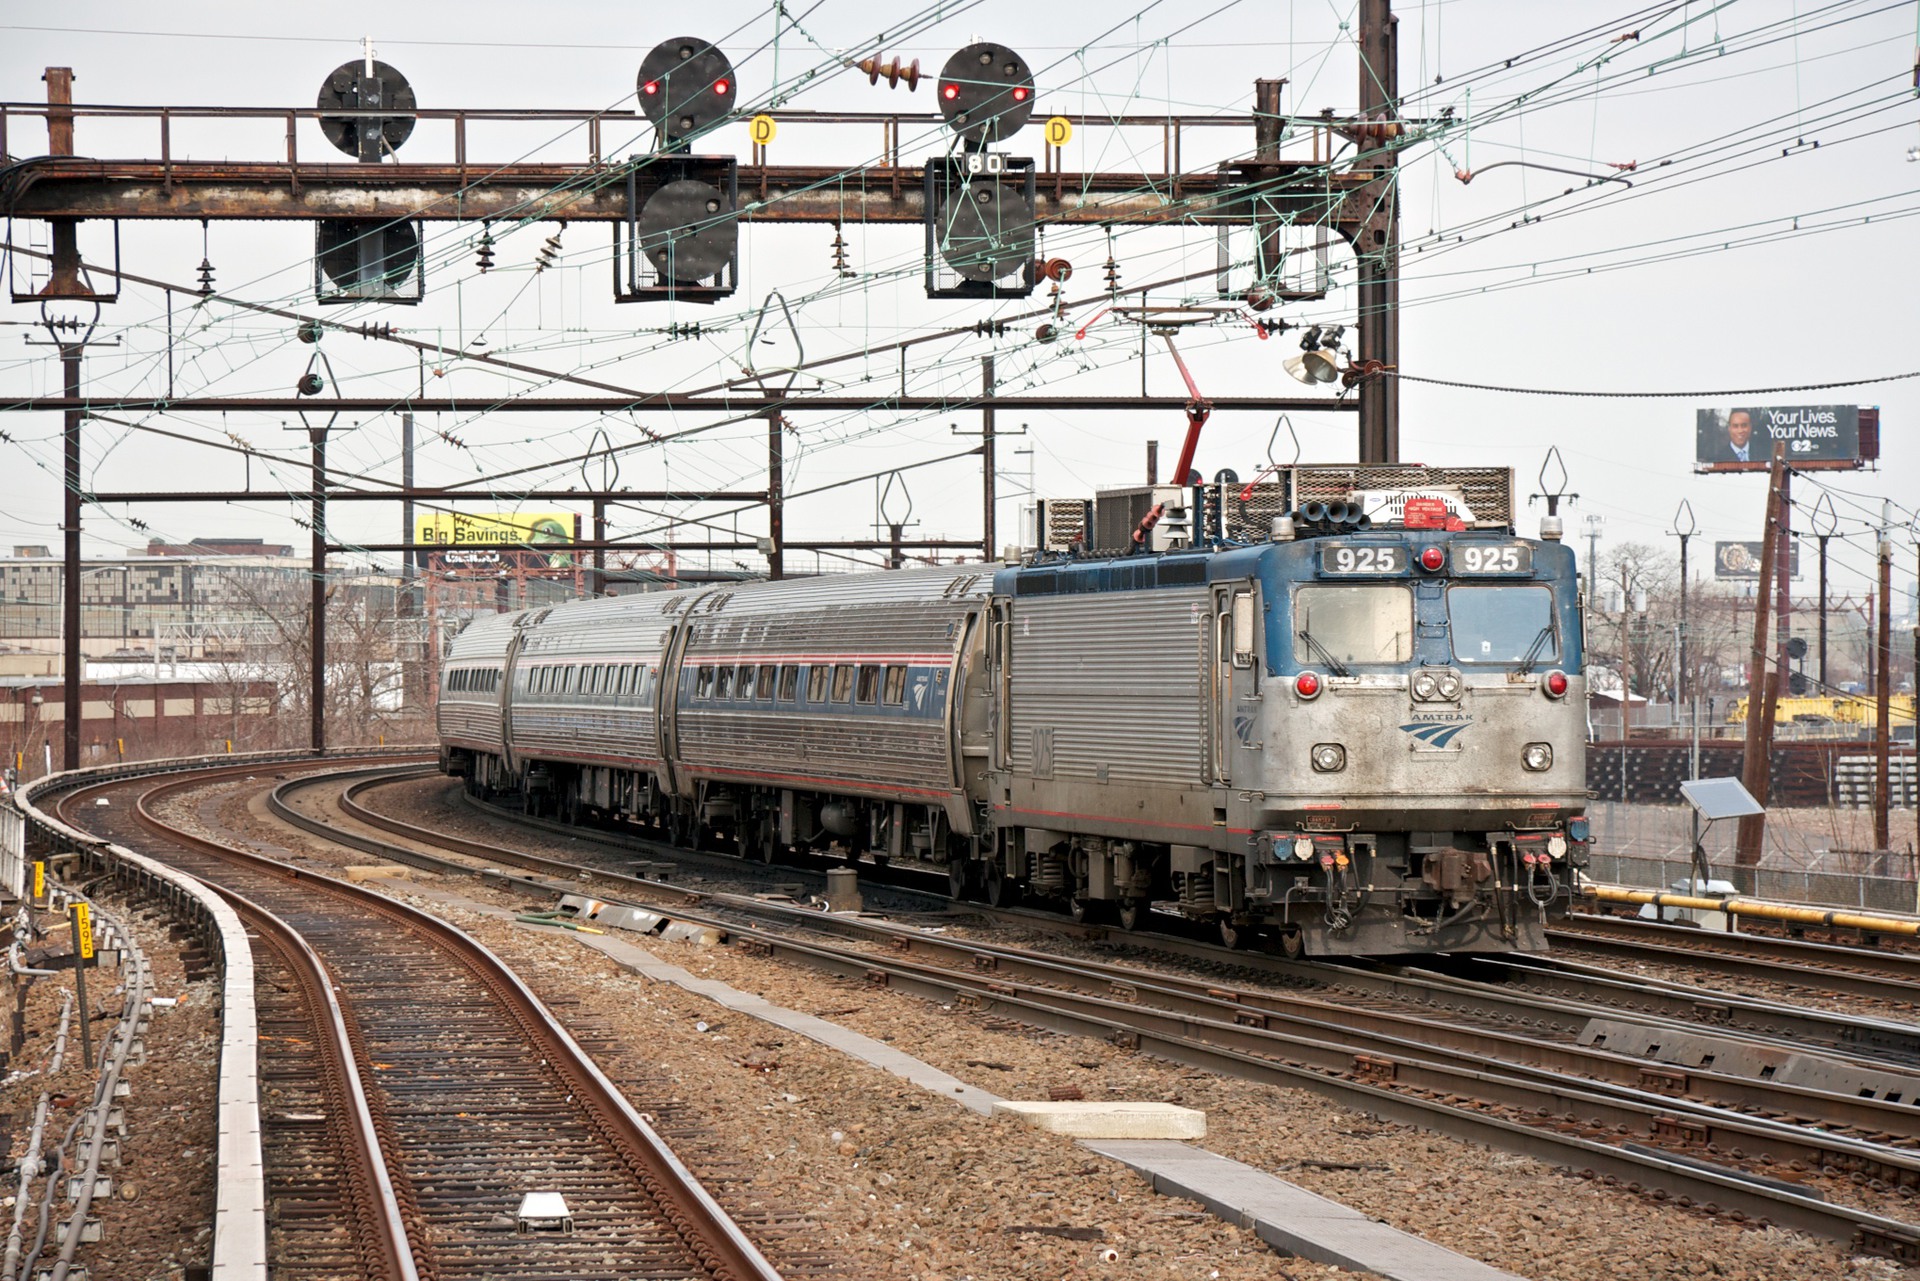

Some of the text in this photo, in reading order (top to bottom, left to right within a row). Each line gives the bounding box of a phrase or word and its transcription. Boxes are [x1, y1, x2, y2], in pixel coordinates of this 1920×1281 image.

[756, 120, 770, 140] D
[1052, 122, 1066, 142] D
[968, 155, 1001, 173] 80
[1768, 409, 1838, 425] Your Lives.
[1766, 423, 1839, 439] Your News.
[423, 527, 522, 545] Bg Savings.
[1336, 547, 1395, 572] 925
[1464, 547, 1519, 572] 925
[1032, 728, 1052, 776] 925
[81, 905, 91, 955] 1595
